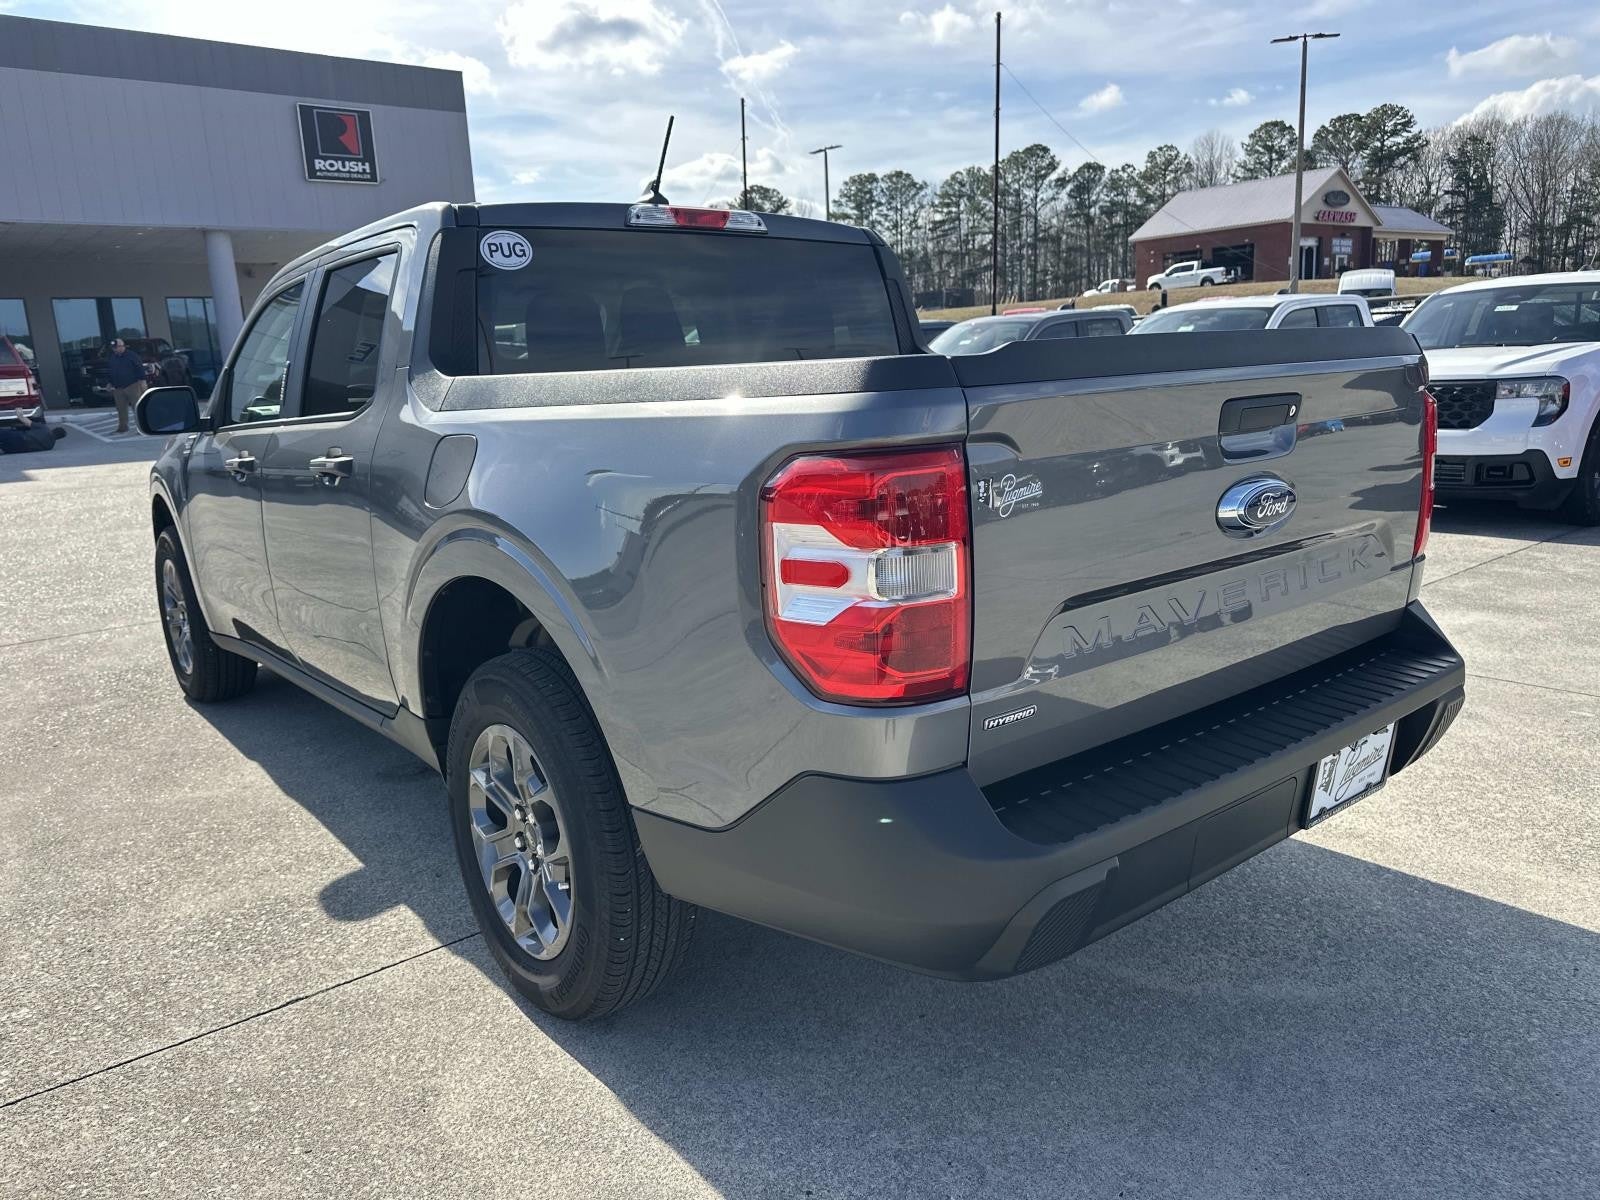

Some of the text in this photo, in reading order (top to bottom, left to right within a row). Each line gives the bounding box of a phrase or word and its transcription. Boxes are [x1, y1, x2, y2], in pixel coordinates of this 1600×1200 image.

[314, 159, 371, 173] ROUSH
[316, 171, 350, 179] AUTHORIZED
[487, 242, 527, 259] PUG
[1000, 473, 1043, 518] Pugmire
[1257, 492, 1289, 518] Ford
[1062, 541, 1372, 660] MAVERICK
[989, 708, 1035, 729] HYBRID
